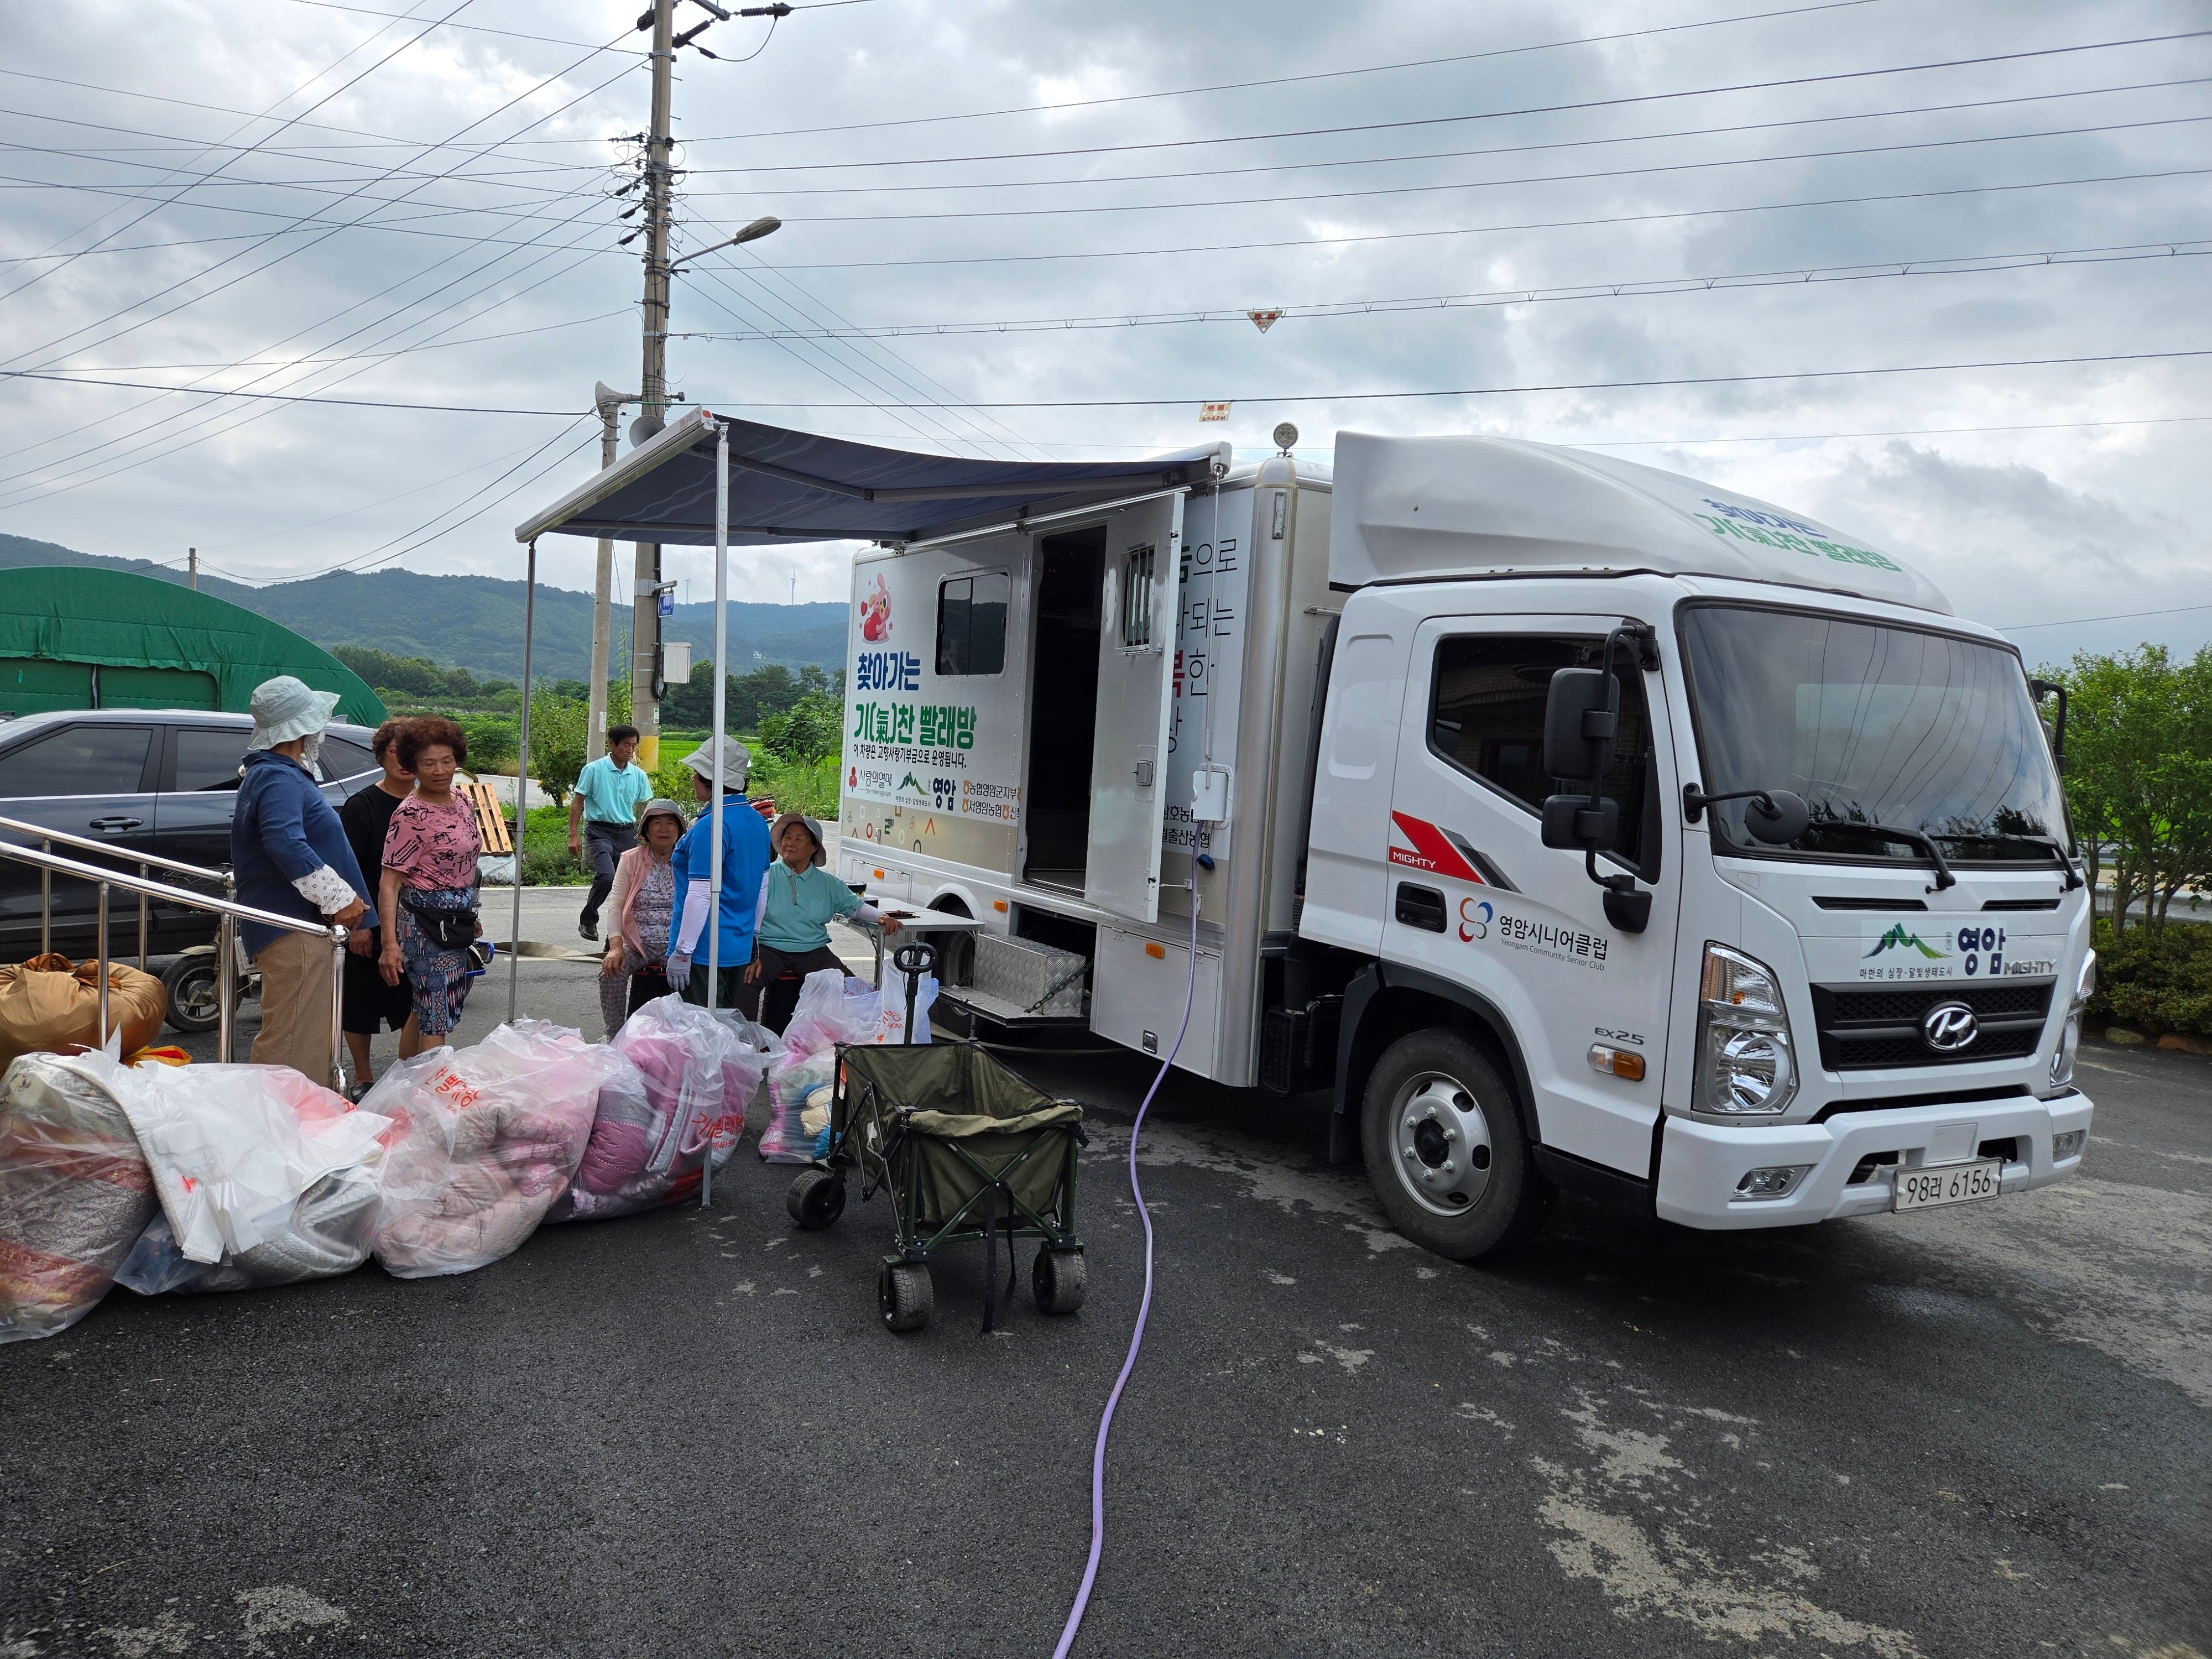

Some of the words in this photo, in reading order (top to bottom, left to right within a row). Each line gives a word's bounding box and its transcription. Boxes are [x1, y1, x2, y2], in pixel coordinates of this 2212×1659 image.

[858, 651, 920, 691] 찾아가는
[854, 702, 915, 744] 기(氣)찬
[920, 705, 977, 749] 빨래방
[853, 743, 859, 758] 이
[860, 744, 877, 760] 차량은
[878, 745, 930, 764] 고향사랑기부금으로
[932, 750, 967, 769] 운영됩니다.
[859, 769, 892, 789] 사랑의열매
[969, 782, 1016, 800] 농협영암군지부
[933, 778, 956, 811] 영암
[968, 800, 1002, 817] 서영암농협
[1393, 851, 1436, 868] MIGHTY
[1500, 916, 1608, 961] 영암시니어클럽
[1958, 927, 2006, 975] 영암
[1501, 937, 1528, 951] Yeongam
[1530, 945, 1565, 961] Community
[1567, 954, 1588, 966] Senior
[1589, 961, 1605, 971] Club
[2004, 959, 2056, 975] MIGHTY
[1860, 968, 1884, 979] 마한의
[1908, 1176, 1942, 1203] 98러
[1949, 1168, 1990, 1198] 6156
